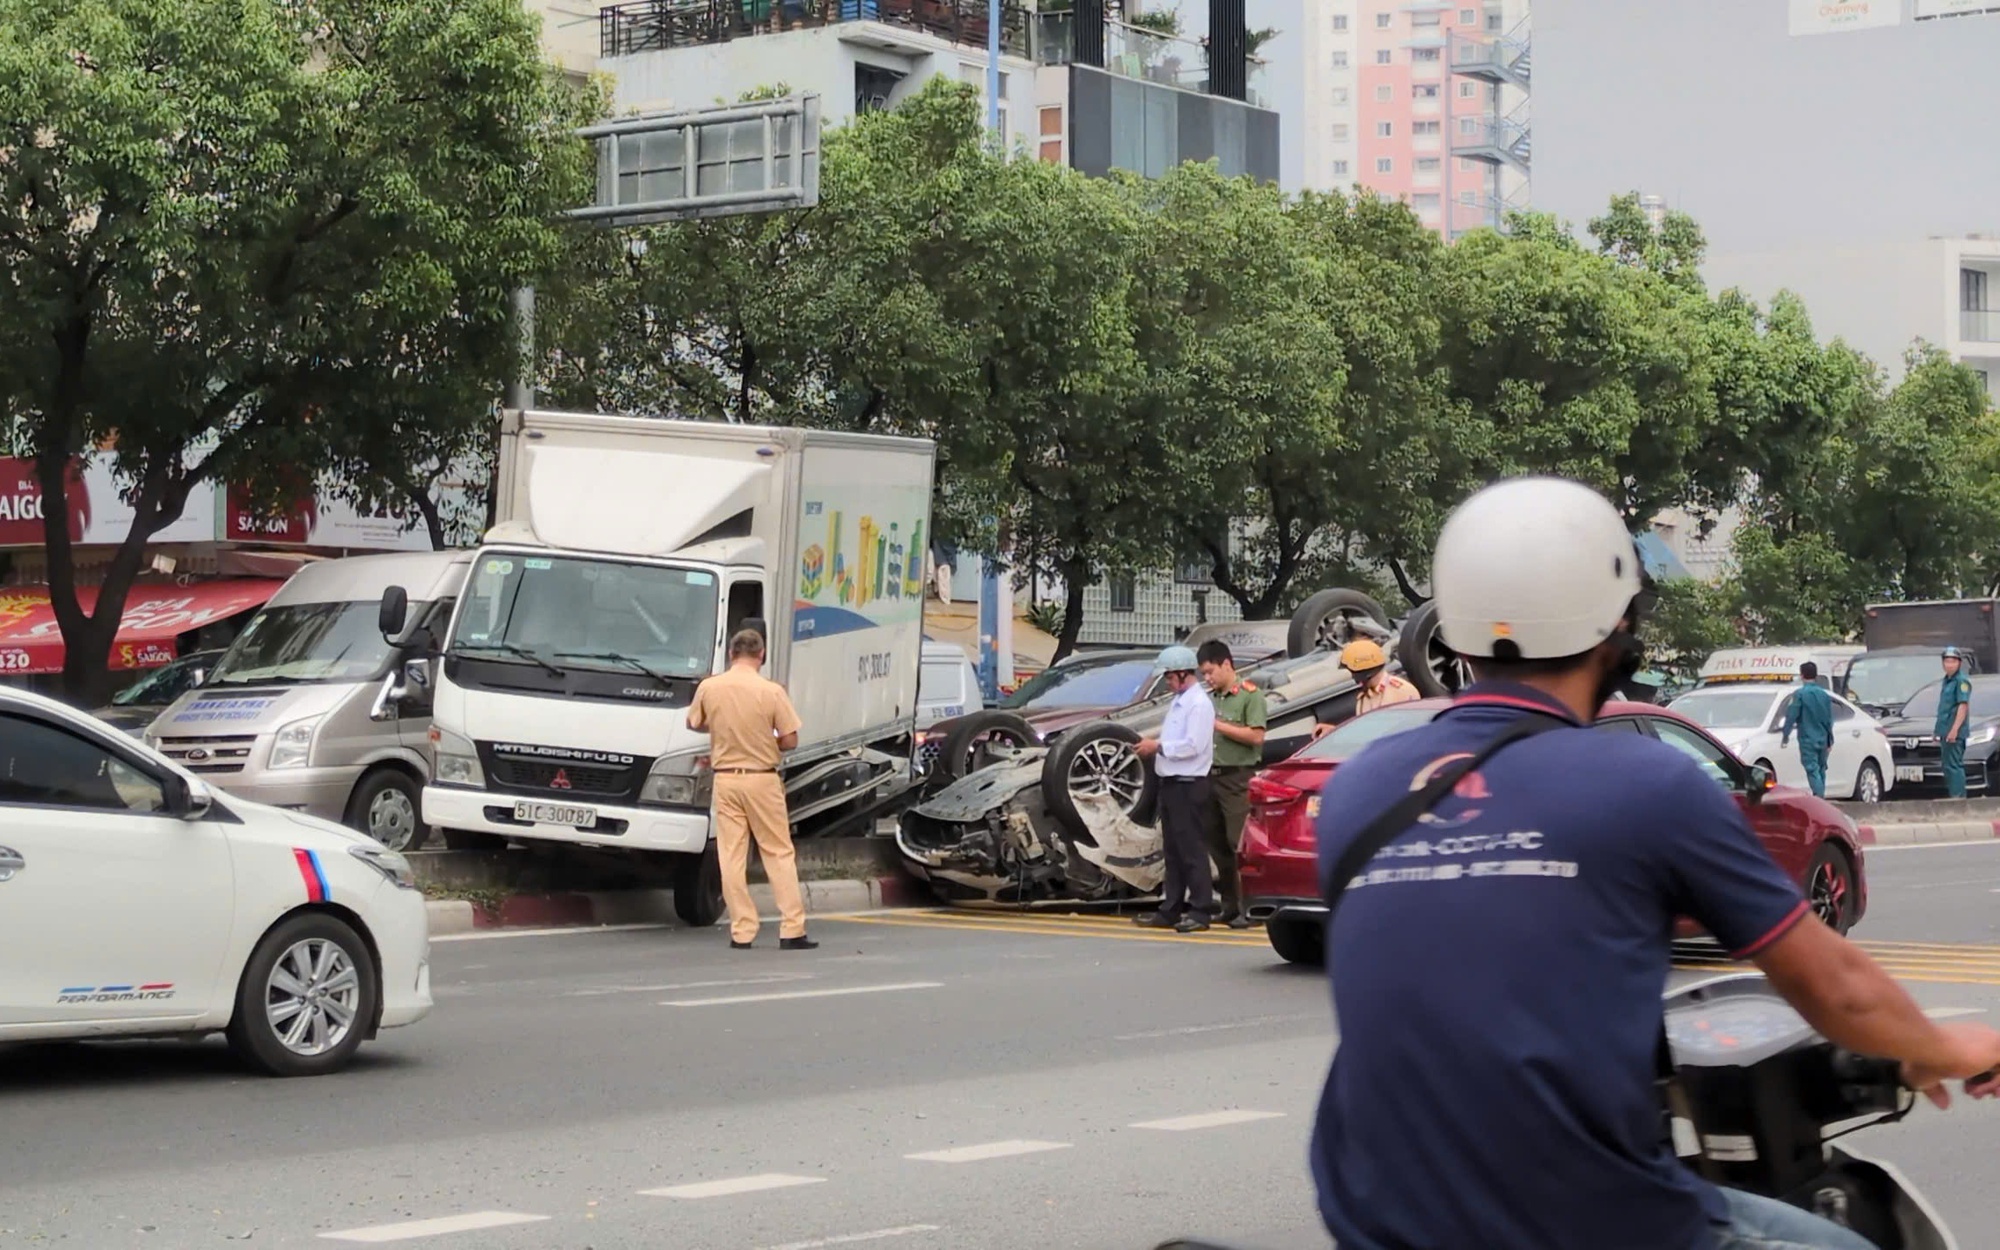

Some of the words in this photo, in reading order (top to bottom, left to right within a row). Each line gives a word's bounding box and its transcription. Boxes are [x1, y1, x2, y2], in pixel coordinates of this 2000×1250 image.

[622, 687, 674, 699] CANTER
[583, 752, 634, 764] FUSO
[57, 991, 175, 1003] PERFORMANCE
